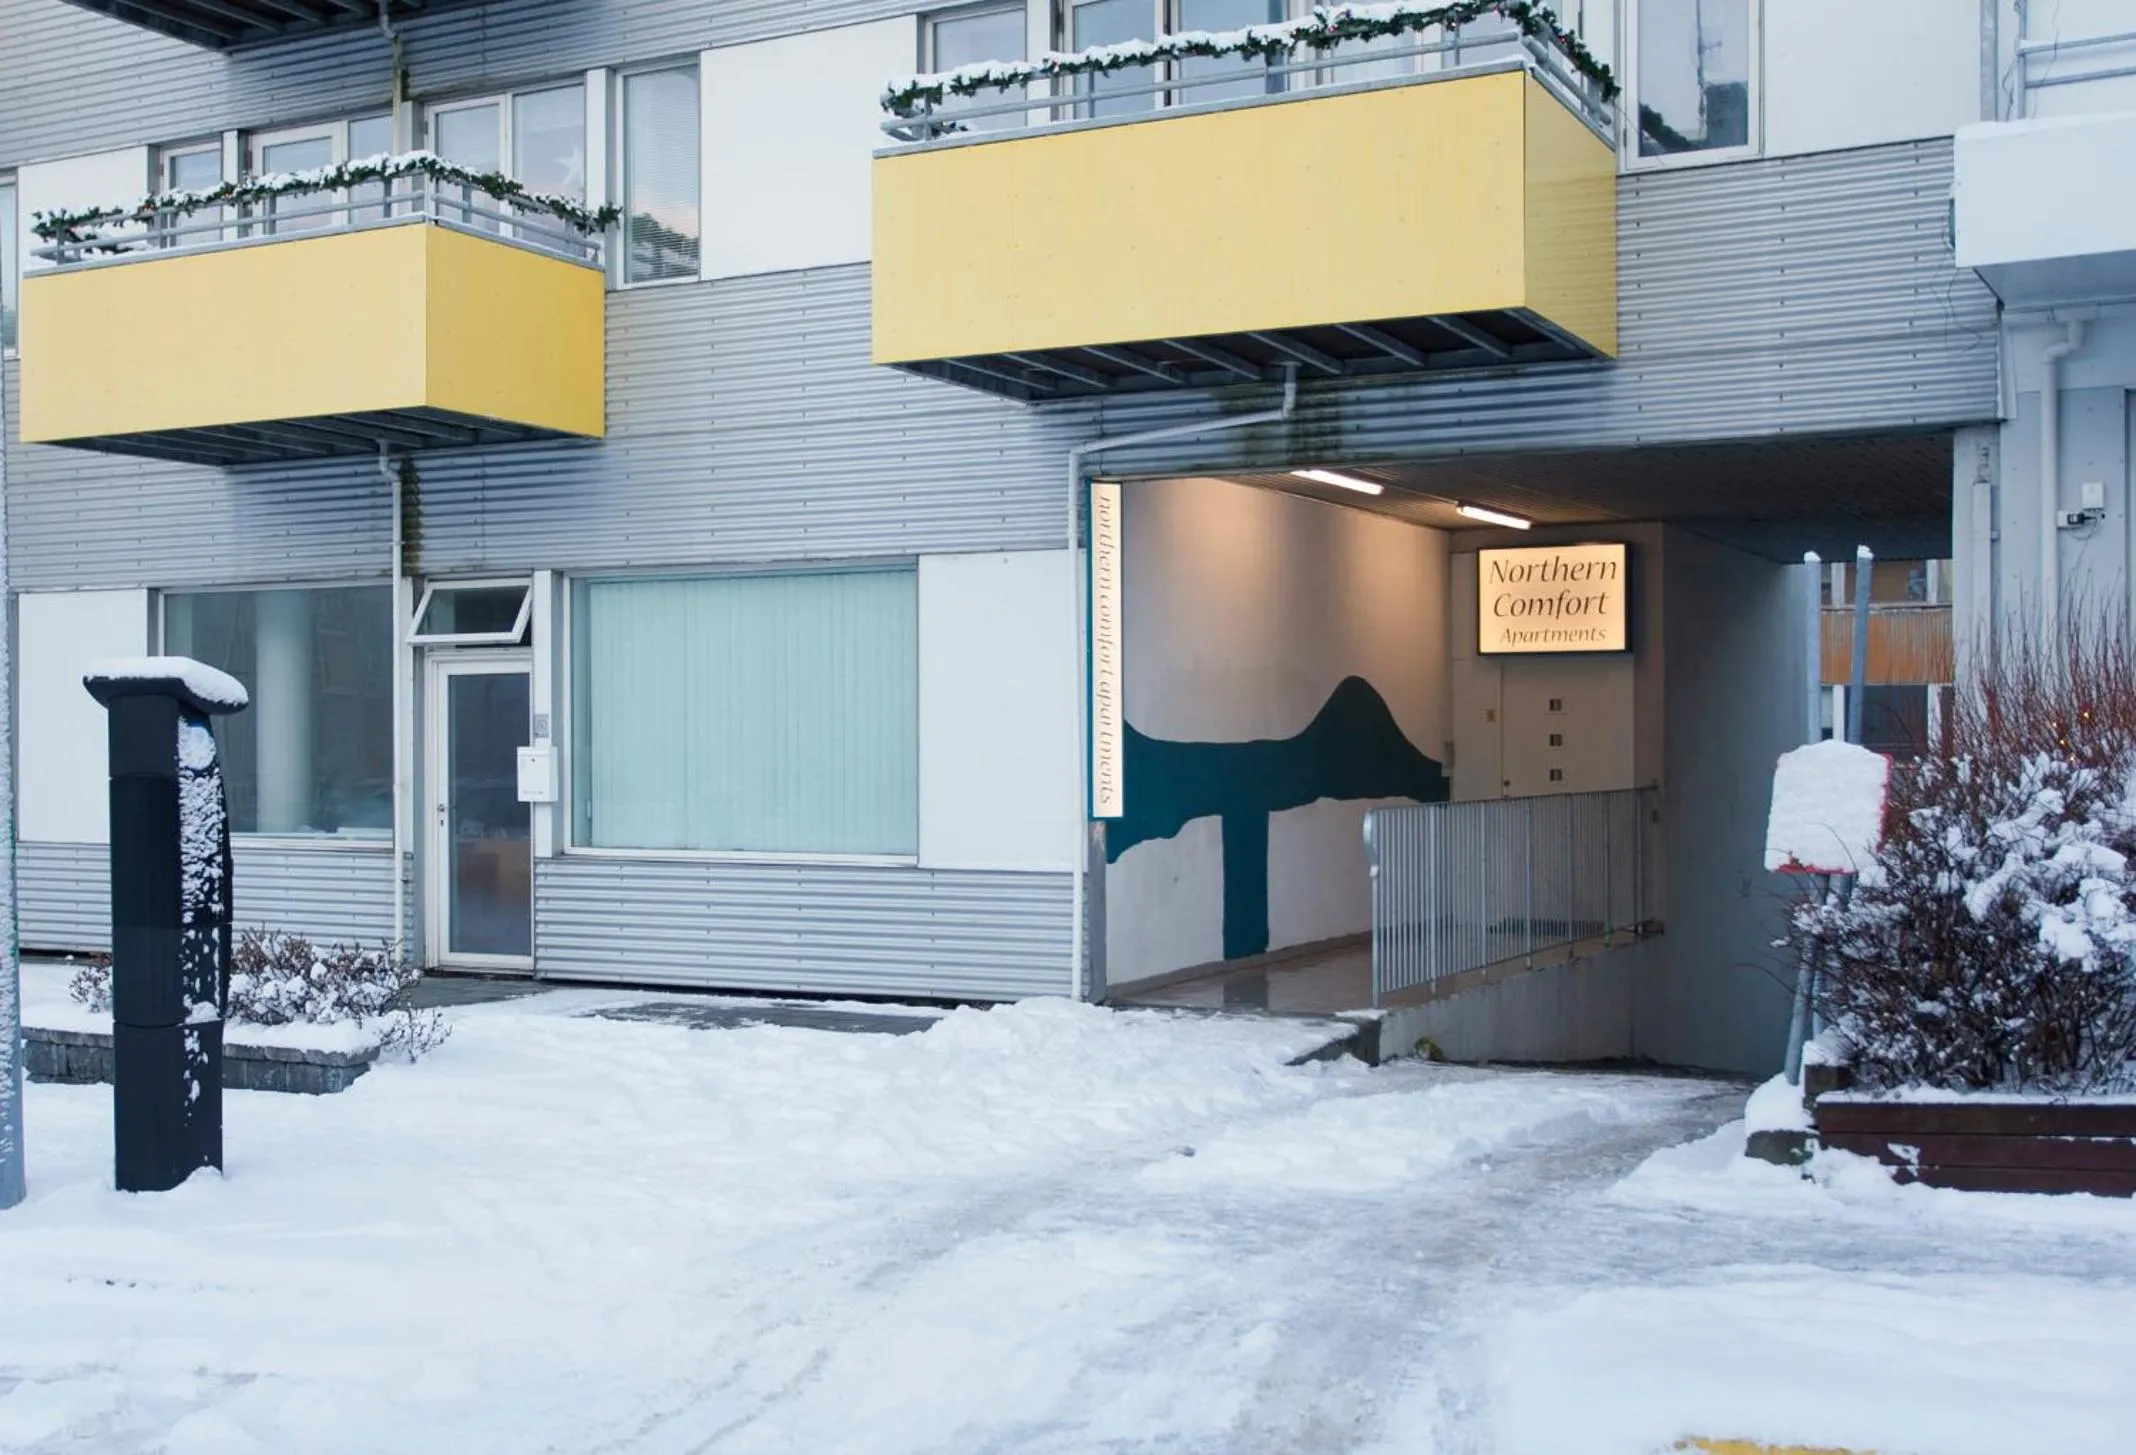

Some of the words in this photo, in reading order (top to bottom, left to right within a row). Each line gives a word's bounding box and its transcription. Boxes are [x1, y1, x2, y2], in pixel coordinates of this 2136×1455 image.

[1099, 496, 1115, 590] northern
[1490, 556, 1617, 584] Northern
[1494, 589, 1610, 620] Comfort
[1097, 593, 1114, 676] comfort
[1501, 627, 1607, 646] Apartments
[1096, 680, 1114, 804] apartments
